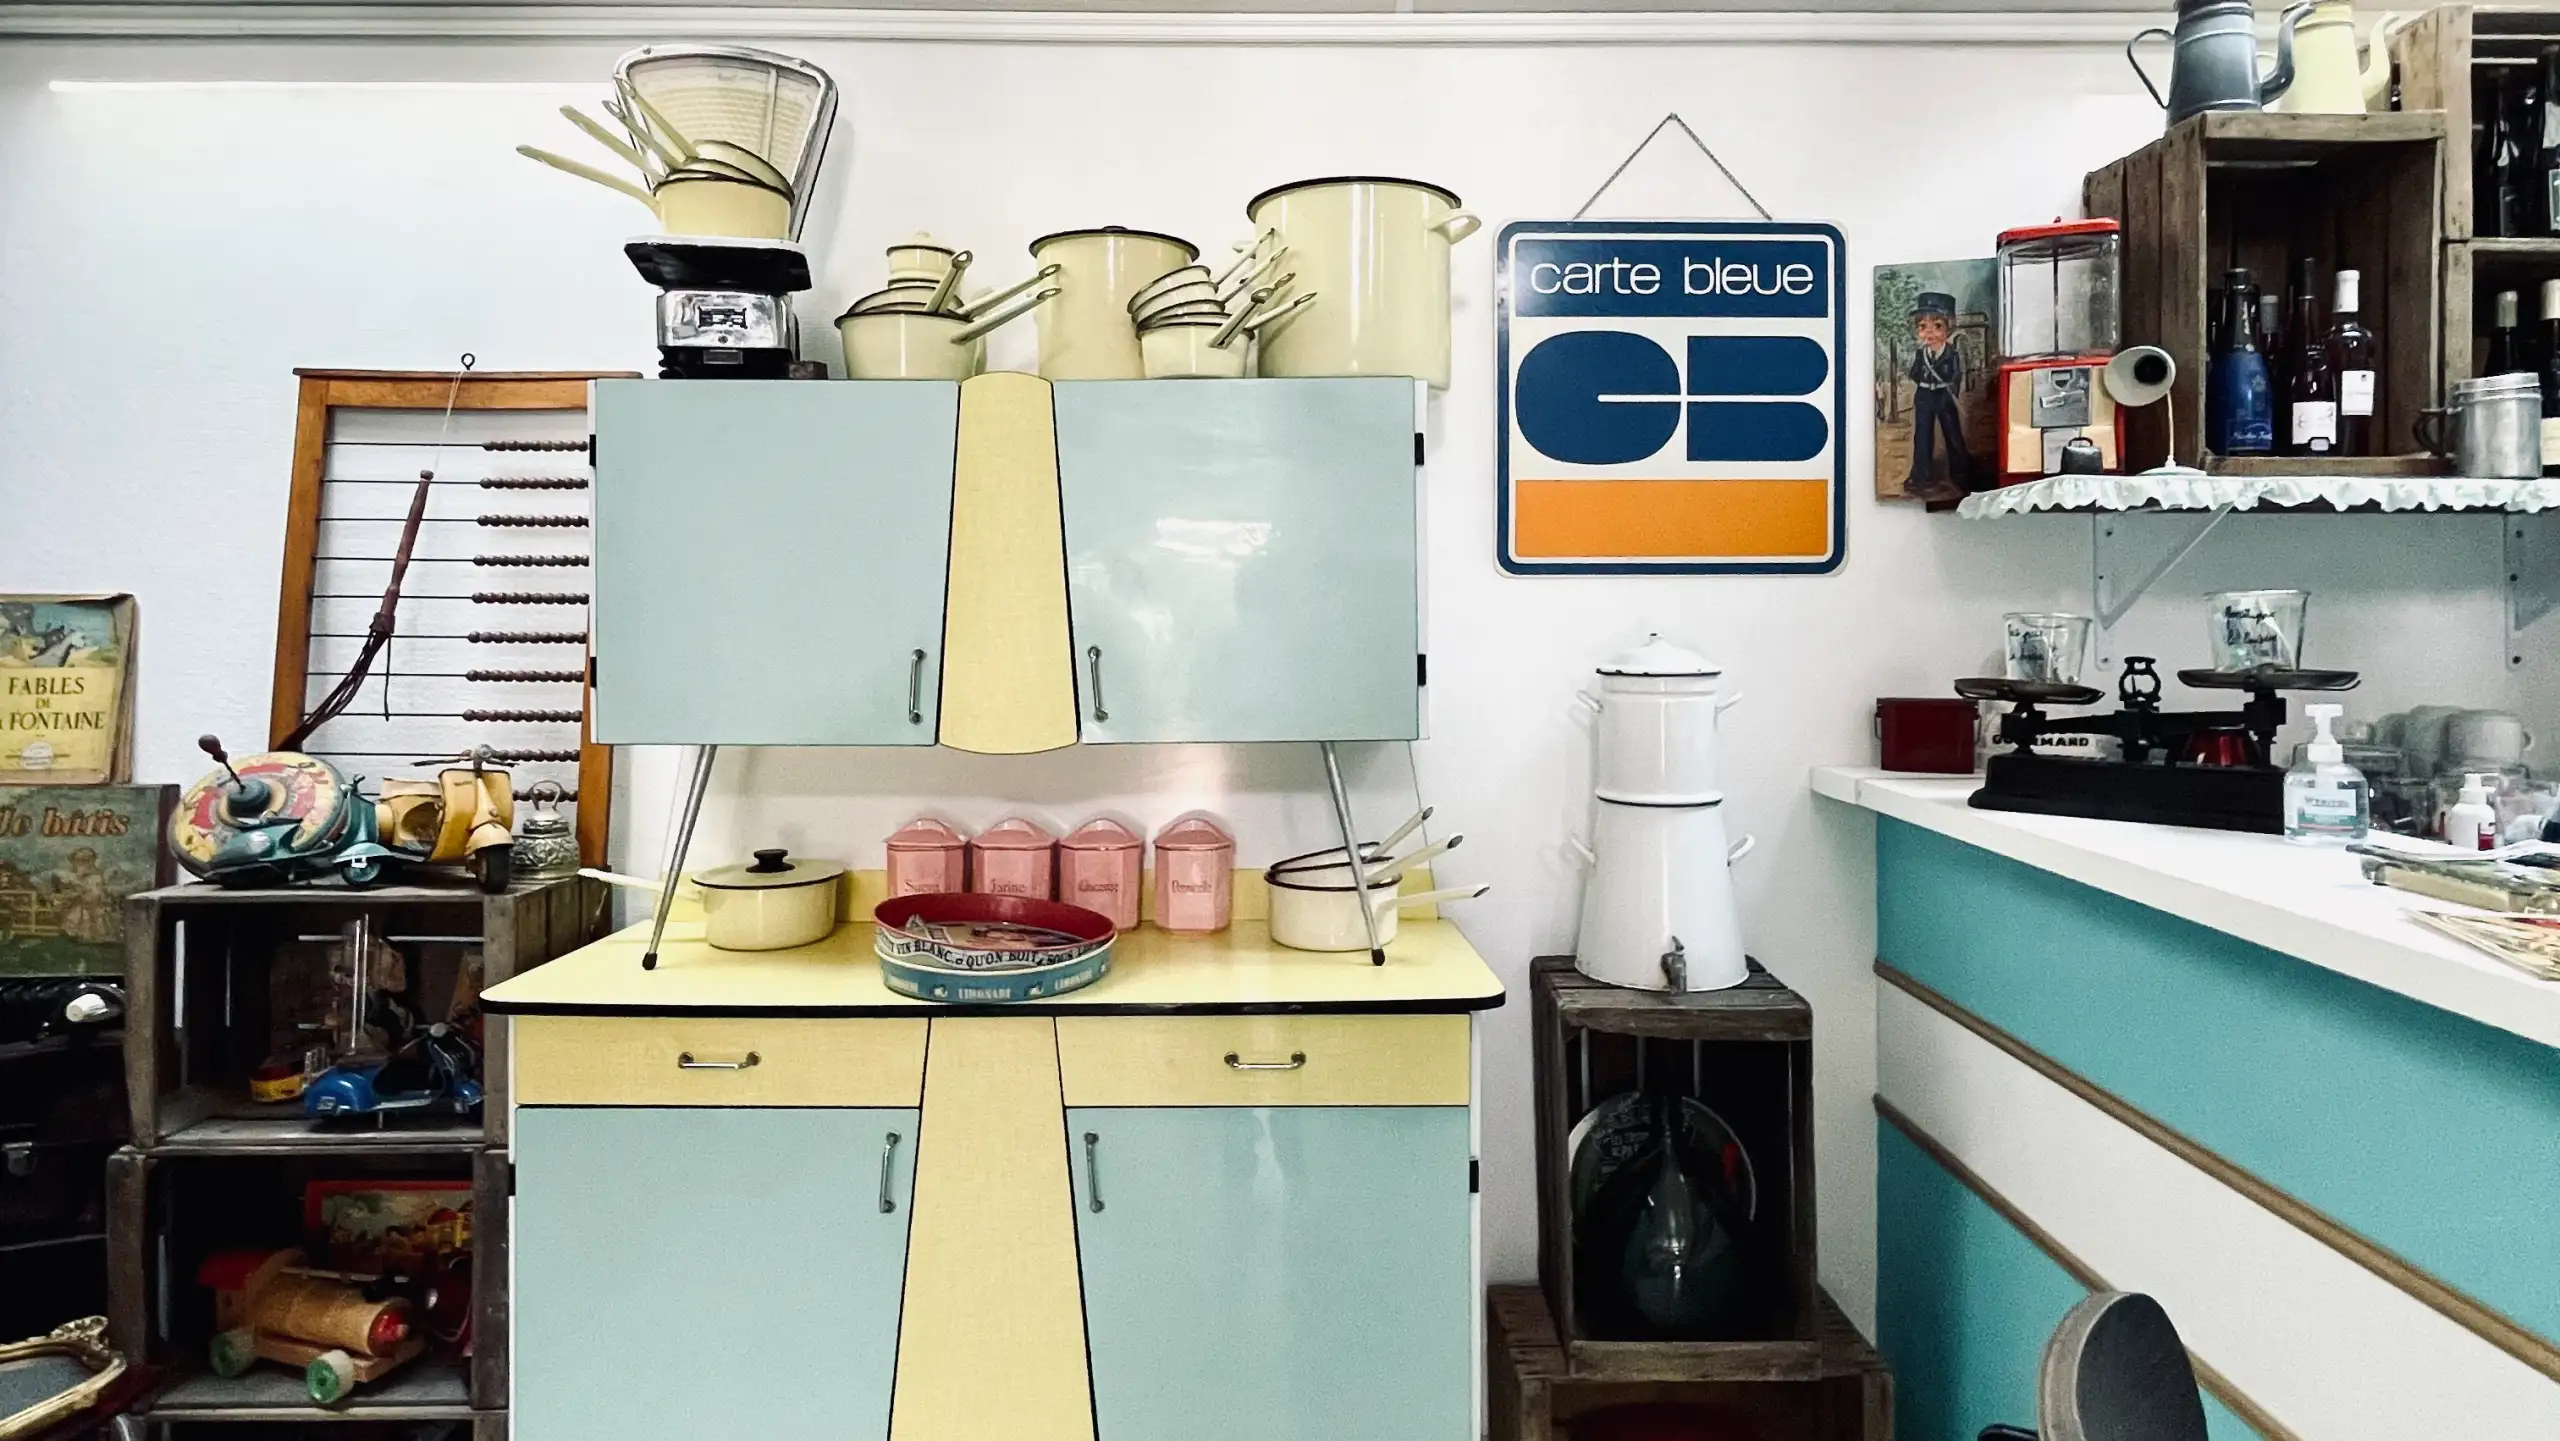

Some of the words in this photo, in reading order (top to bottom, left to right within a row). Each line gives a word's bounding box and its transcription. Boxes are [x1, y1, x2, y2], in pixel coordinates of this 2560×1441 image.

[1530, 256, 1661, 295] carte
[1684, 256, 1814, 296] bleue
[1515, 330, 1829, 465] CB
[9, 677, 85, 695] FABLES
[10, 711, 107, 731] FONTAINE
